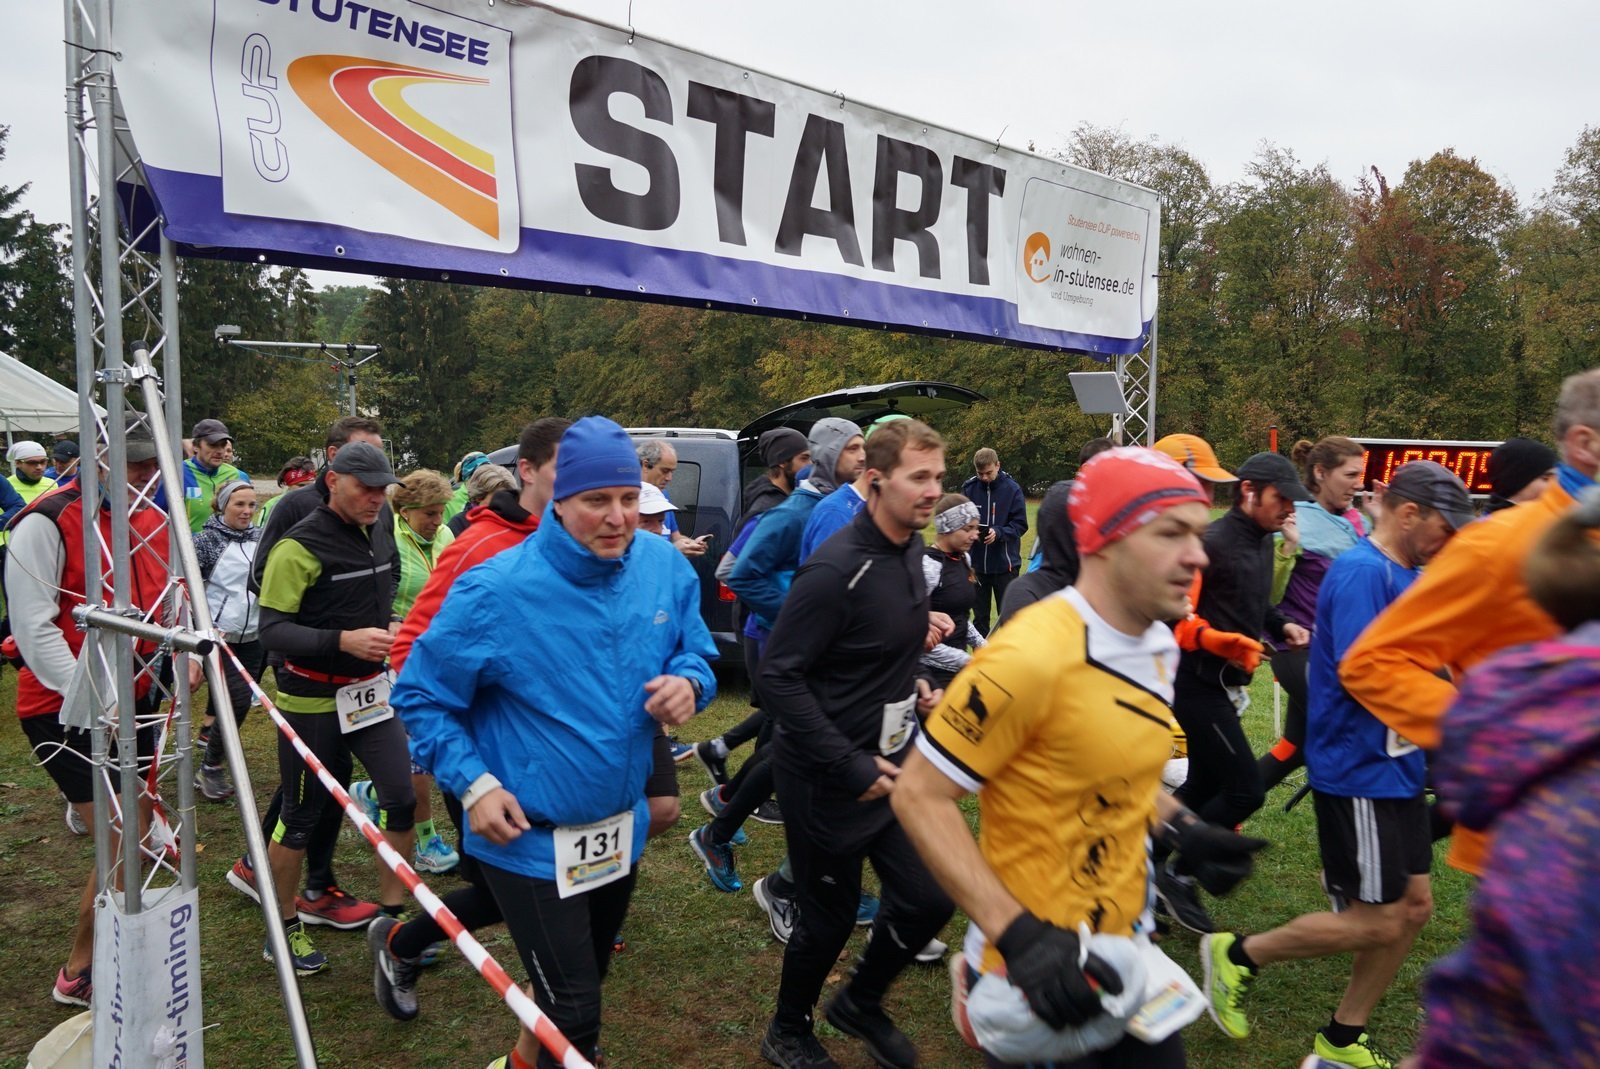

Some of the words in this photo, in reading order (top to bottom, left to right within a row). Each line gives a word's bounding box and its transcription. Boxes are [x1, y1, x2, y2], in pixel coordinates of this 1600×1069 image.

[258, 0, 490, 66] UTENSEE
[241, 33, 289, 182] CUP
[569, 55, 1007, 286] START
[1067, 214, 1098, 231] Stutensee
[1111, 228, 1134, 240] powered
[1060, 243, 1102, 265] wohnen-
[1053, 264, 1135, 296] in-stutensee.de
[1050, 291, 1063, 300] und
[1063, 291, 1094, 307] Umgebung
[354, 688, 376, 707] 16
[574, 827, 620, 861] 131
